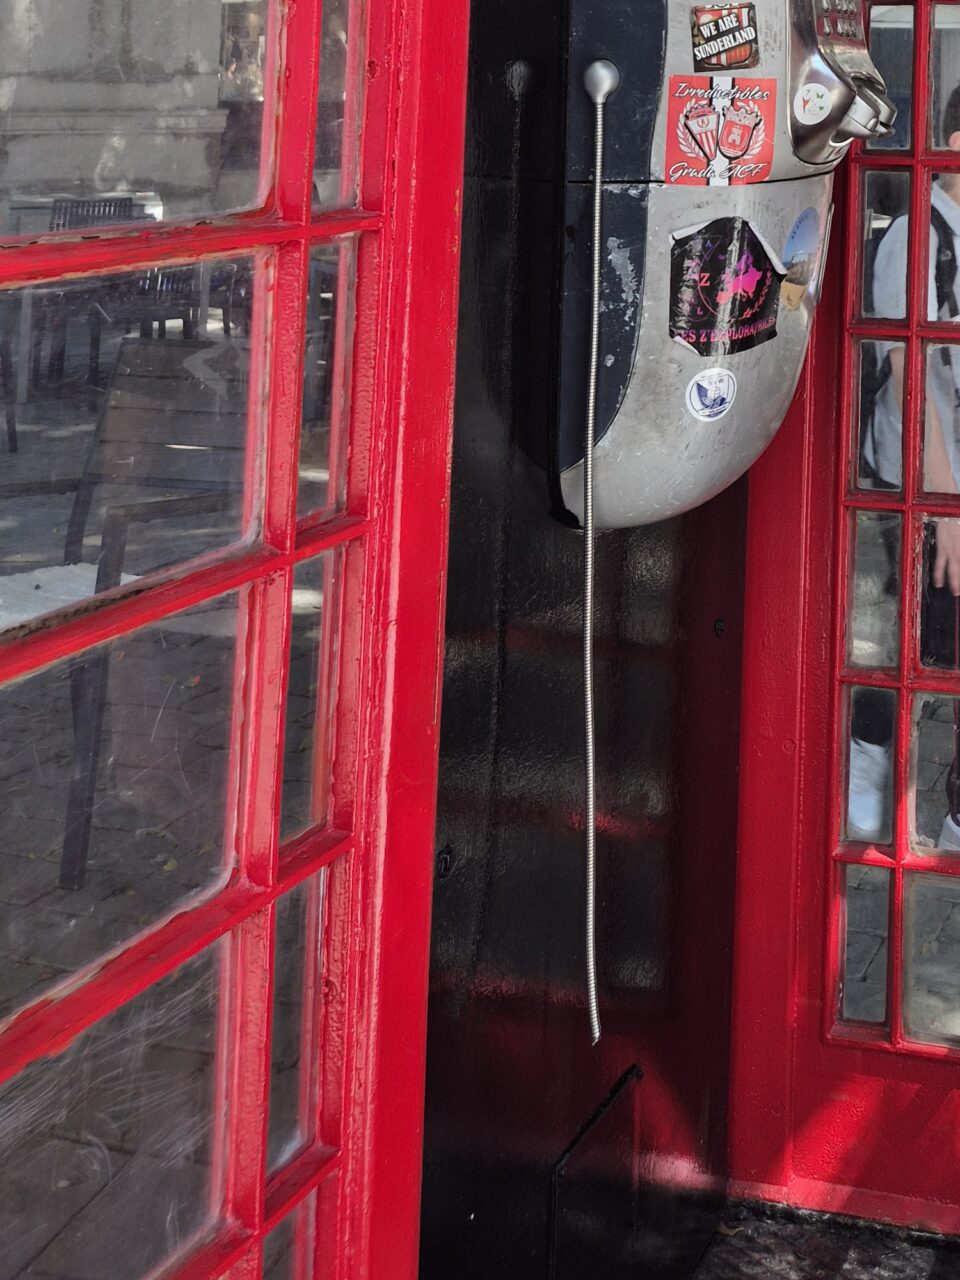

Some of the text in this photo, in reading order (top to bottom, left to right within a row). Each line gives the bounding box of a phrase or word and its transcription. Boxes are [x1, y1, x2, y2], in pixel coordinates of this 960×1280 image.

[700, 13, 738, 38] WE ARE
[694, 26, 755, 60] SUNDERLAND
